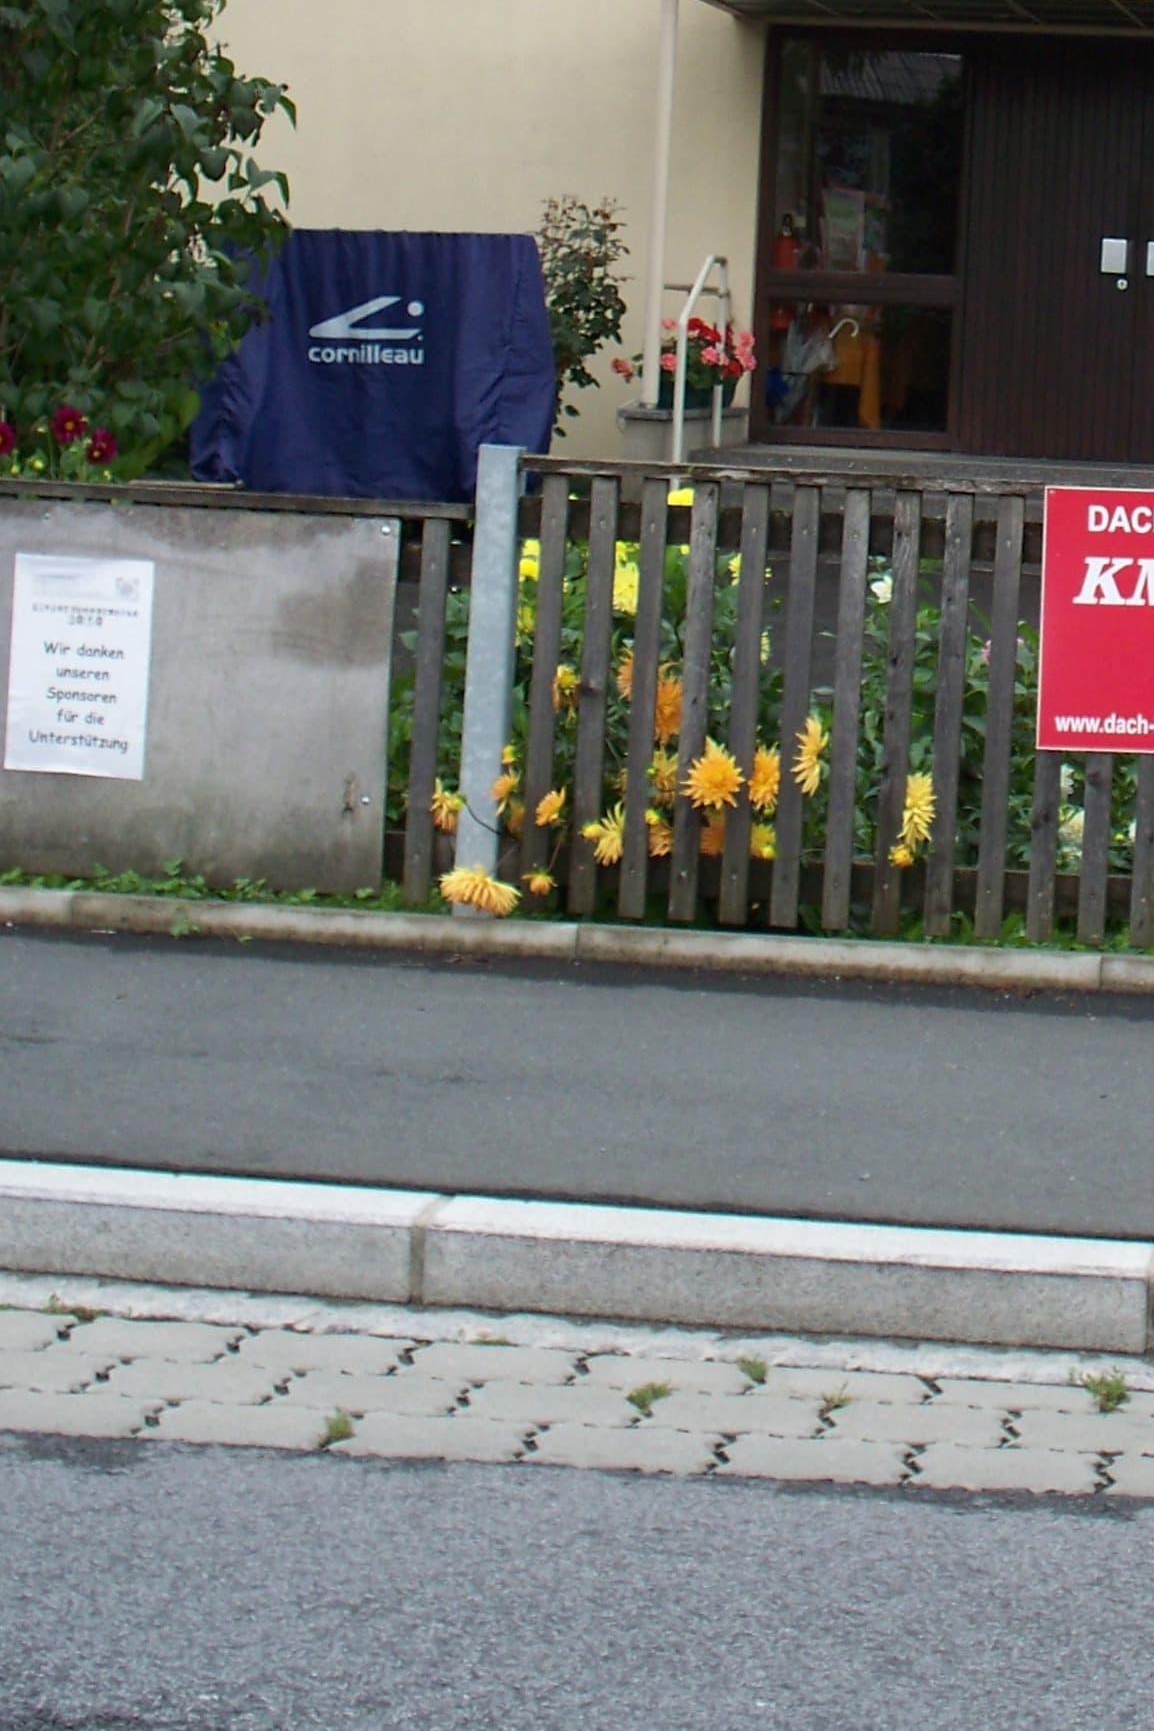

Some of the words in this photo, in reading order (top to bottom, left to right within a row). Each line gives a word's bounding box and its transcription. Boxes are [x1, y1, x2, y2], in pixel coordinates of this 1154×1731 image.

[308, 344, 424, 364] cornilleau
[44, 642, 70, 655] Wir
[76, 645, 124, 660] danken
[56, 667, 110, 681] unseren
[47, 687, 117, 705] Sponsoren
[57, 709, 78, 724] für
[84, 713, 105, 726] die
[29, 730, 129, 754] Unterstützung
